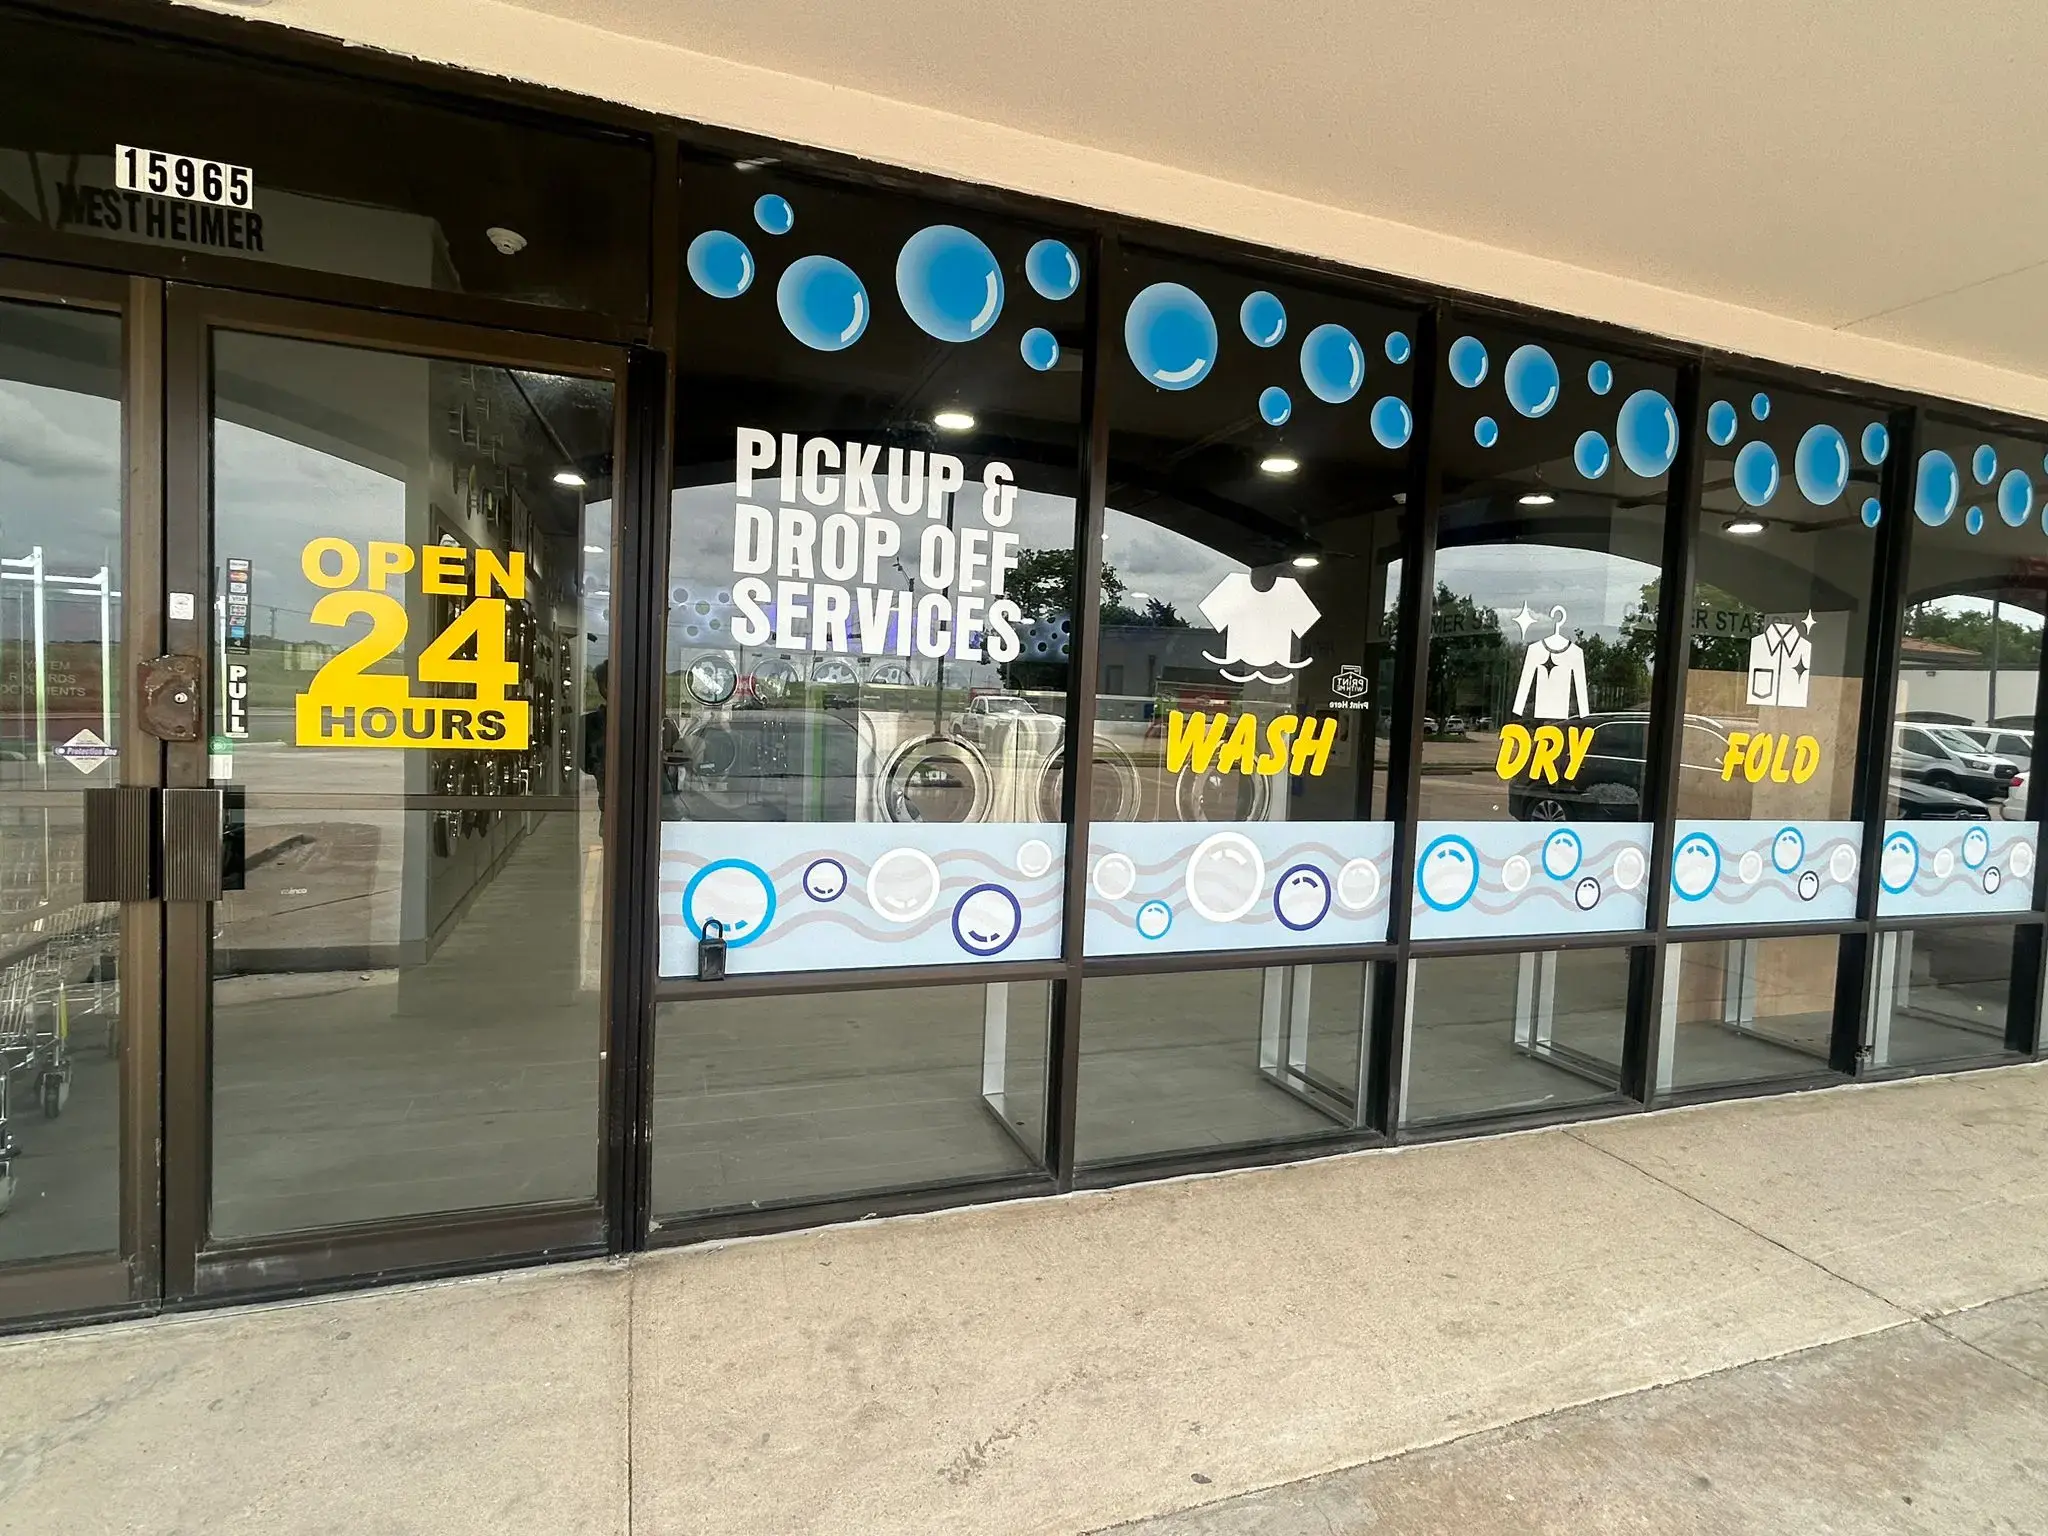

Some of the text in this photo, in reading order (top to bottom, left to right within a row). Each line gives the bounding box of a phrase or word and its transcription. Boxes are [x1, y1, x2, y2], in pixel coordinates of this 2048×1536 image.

[124, 148, 248, 206] 15965
[736, 426, 1018, 528] PICKUP &
[301, 537, 526, 600] OPEN
[733, 502, 1020, 596] DROP OFF
[308, 590, 519, 700] 24
[731, 577, 1022, 663] SERVICES
[229, 665, 247, 731] PULL
[320, 705, 507, 741] HOURS
[1166, 710, 1338, 777] WASH
[1495, 723, 1596, 785] DRY
[1720, 732, 1820, 785] FOLD
